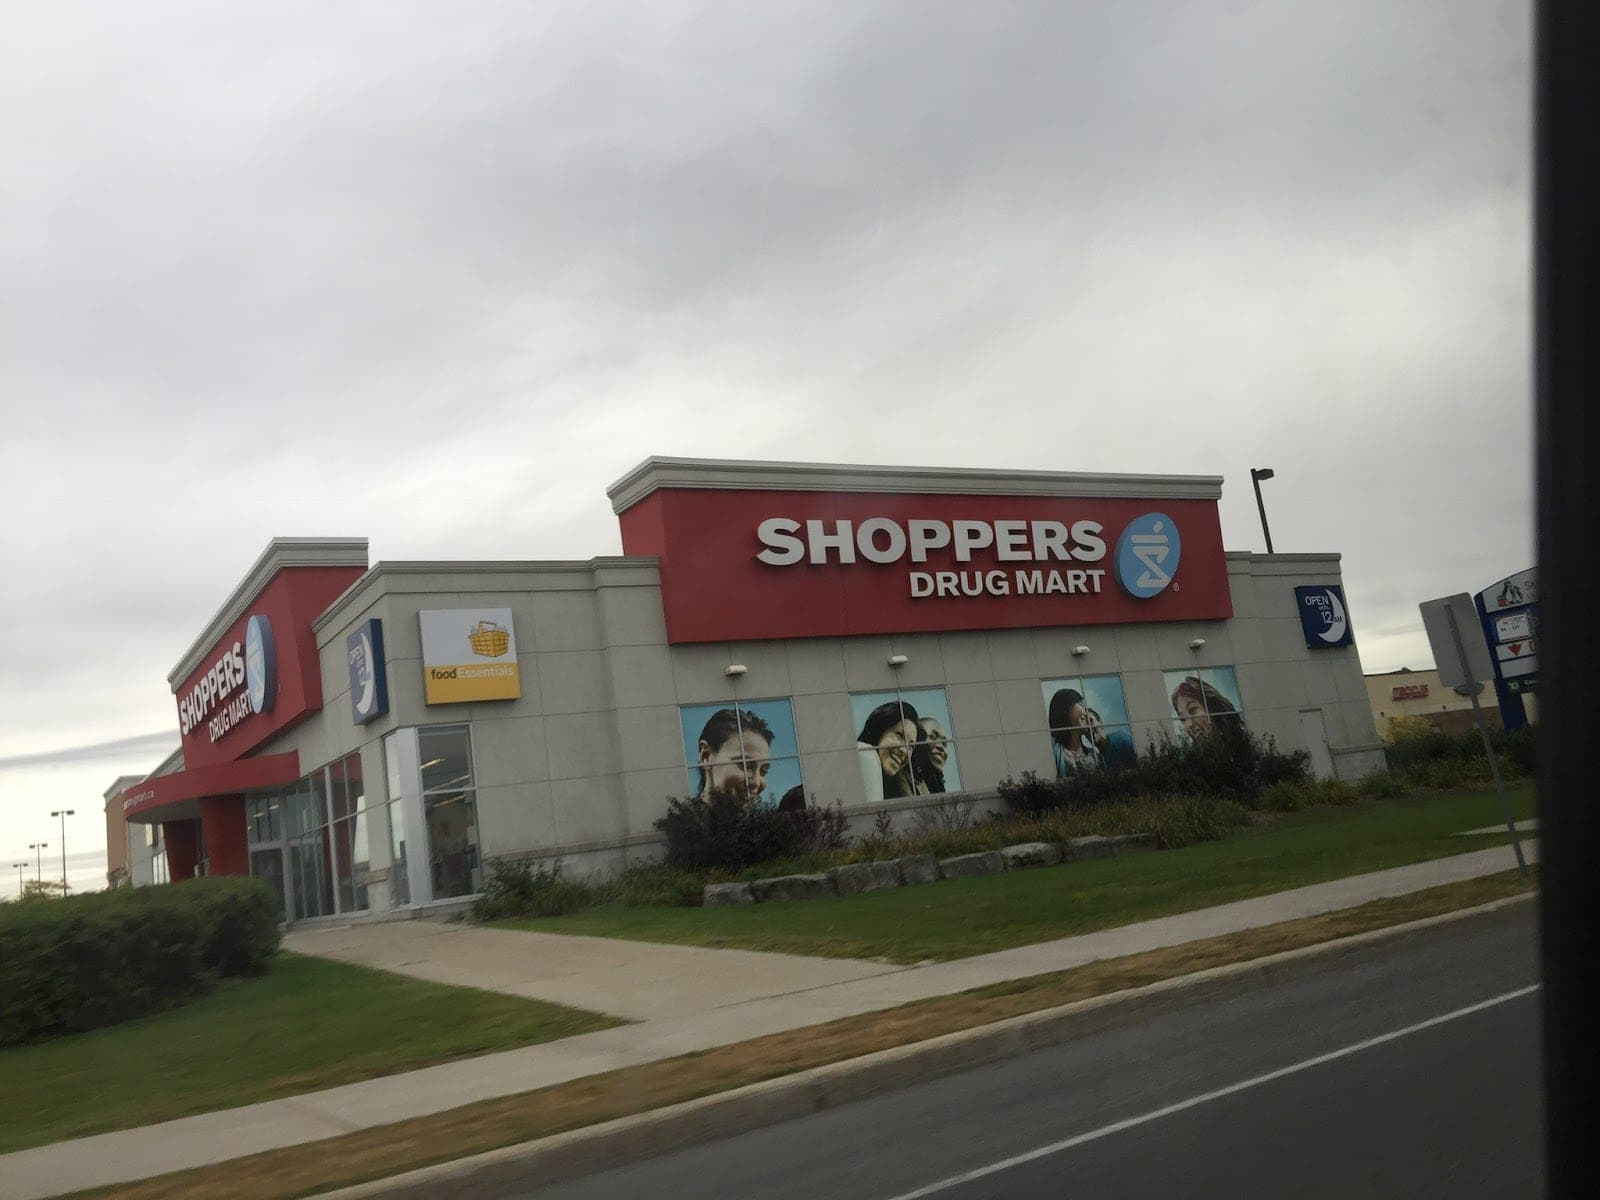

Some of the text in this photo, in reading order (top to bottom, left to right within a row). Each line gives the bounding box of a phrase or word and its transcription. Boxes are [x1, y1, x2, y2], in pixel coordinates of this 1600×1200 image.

[756, 517, 1107, 566] SHOPPERS
[909, 569, 1106, 598] DRUG MART
[1305, 595, 1329, 606] OPEN
[1321, 611, 1333, 624] 12
[180, 642, 244, 735] SHOPPERS
[431, 668, 457, 680] food
[208, 691, 253, 743] DRUG MART
